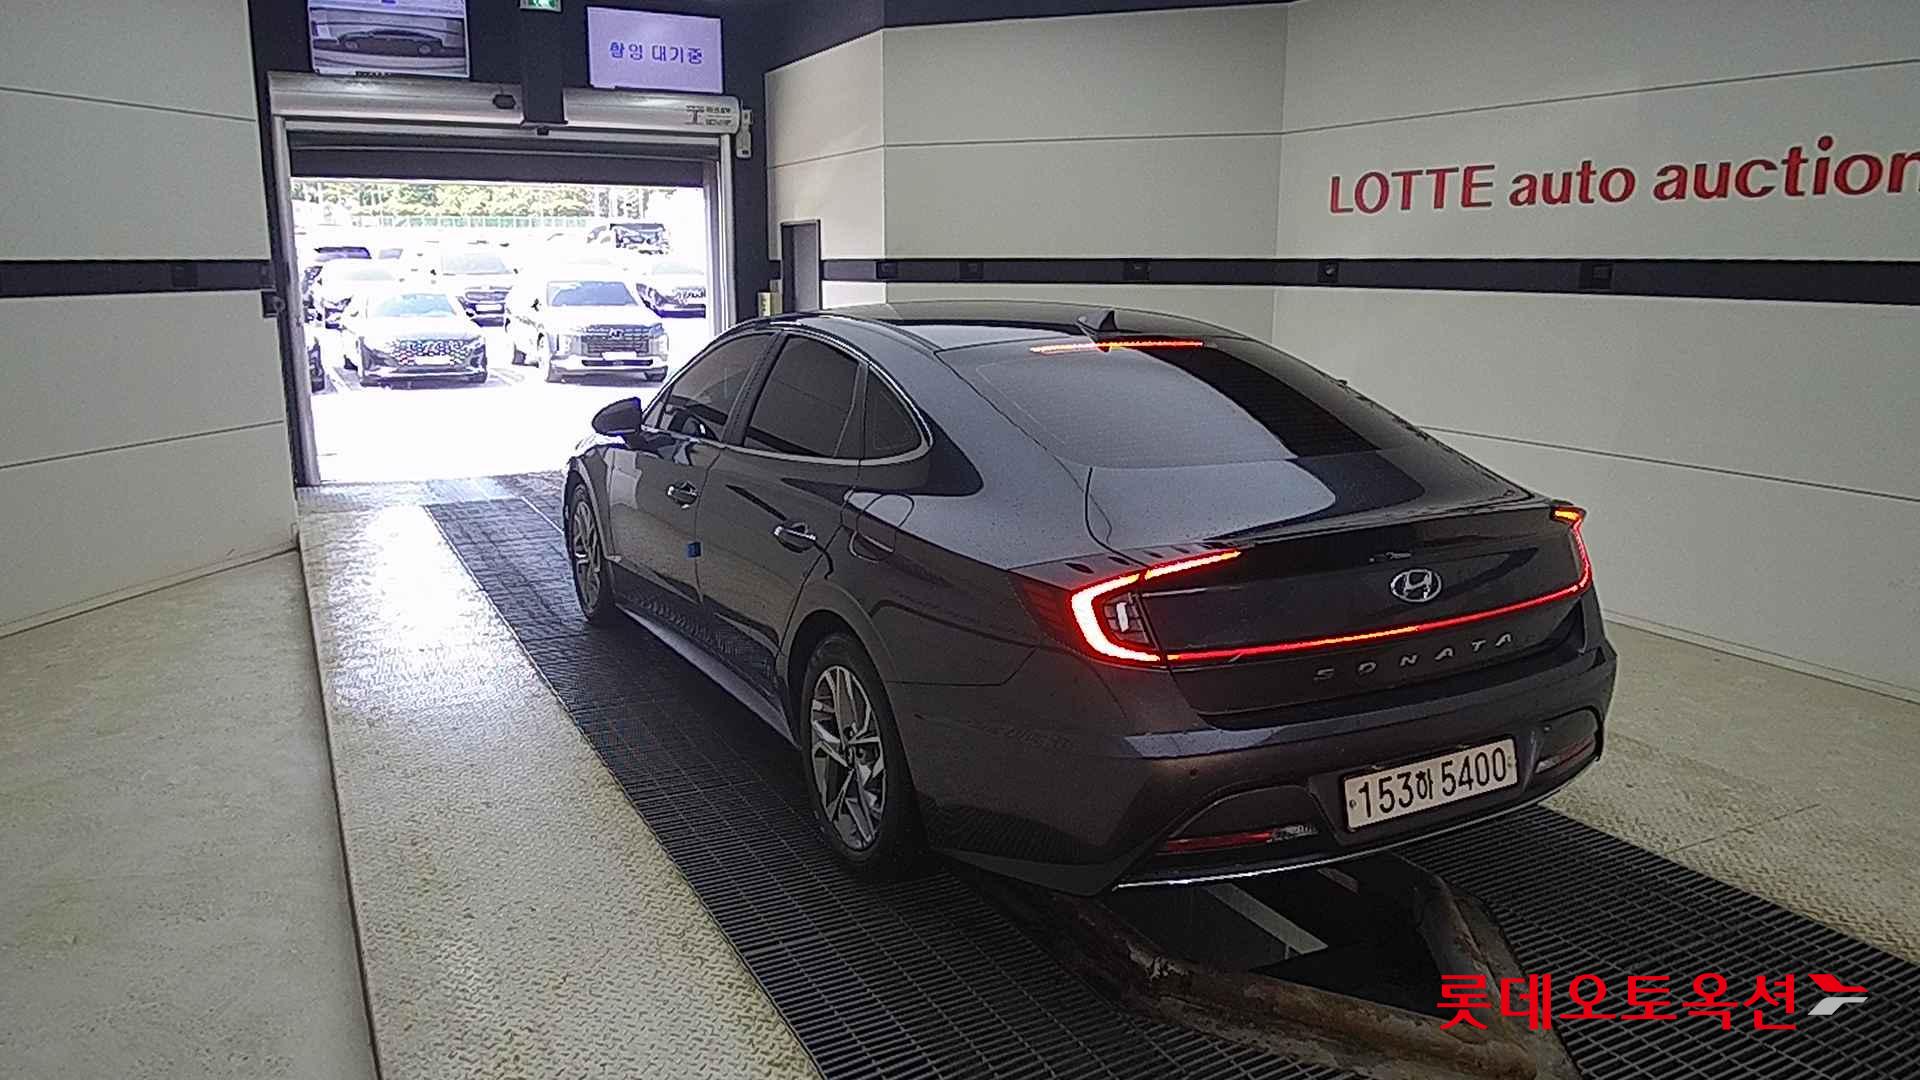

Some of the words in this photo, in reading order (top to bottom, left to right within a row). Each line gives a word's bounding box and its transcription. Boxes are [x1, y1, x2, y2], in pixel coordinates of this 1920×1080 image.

[1329, 164, 1496, 214] LOTTE
[1509, 160, 1637, 206] auto
[1313, 633, 1512, 681] SONATA
[1440, 747, 1507, 796] 5400
